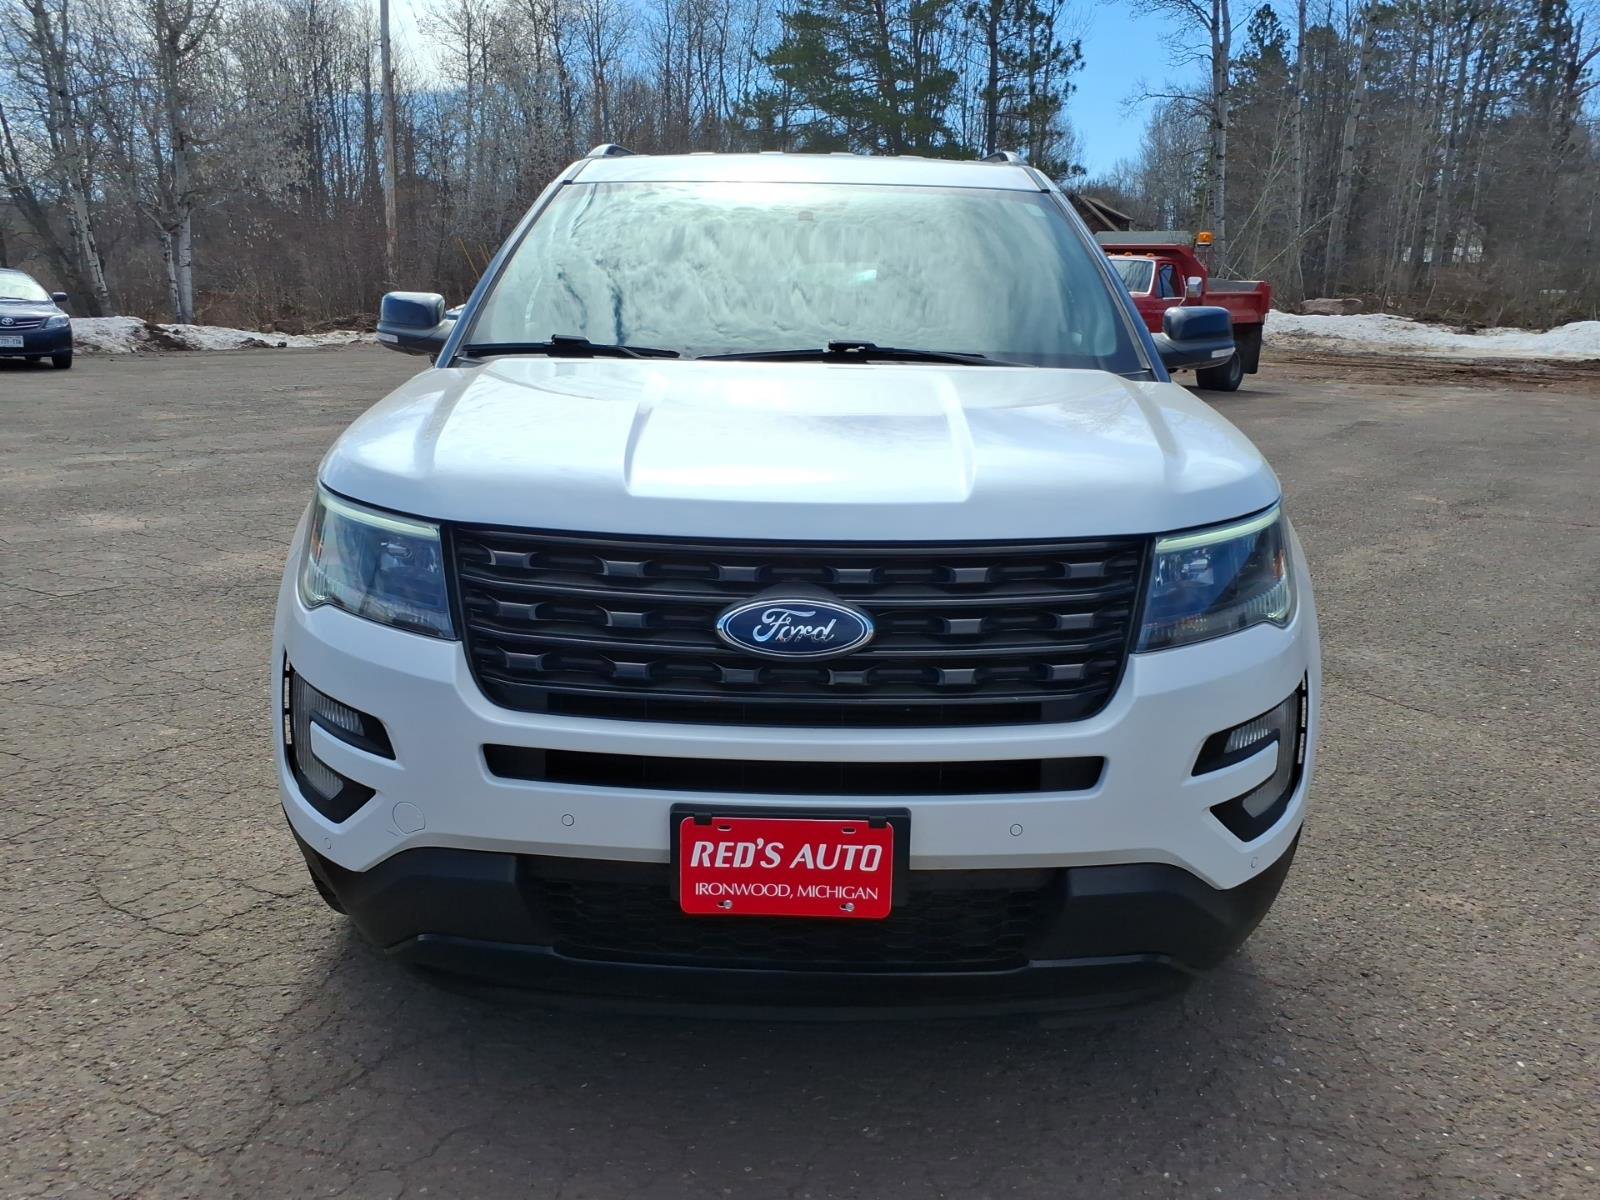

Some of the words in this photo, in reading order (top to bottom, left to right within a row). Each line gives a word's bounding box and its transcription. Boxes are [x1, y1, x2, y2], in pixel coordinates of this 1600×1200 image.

[752, 608, 837, 642] Ford
[690, 838, 784, 869] RED'S
[789, 843, 883, 872] AUTO
[695, 882, 794, 899] IRONWOOD,
[797, 885, 878, 900] MICHIGAN
